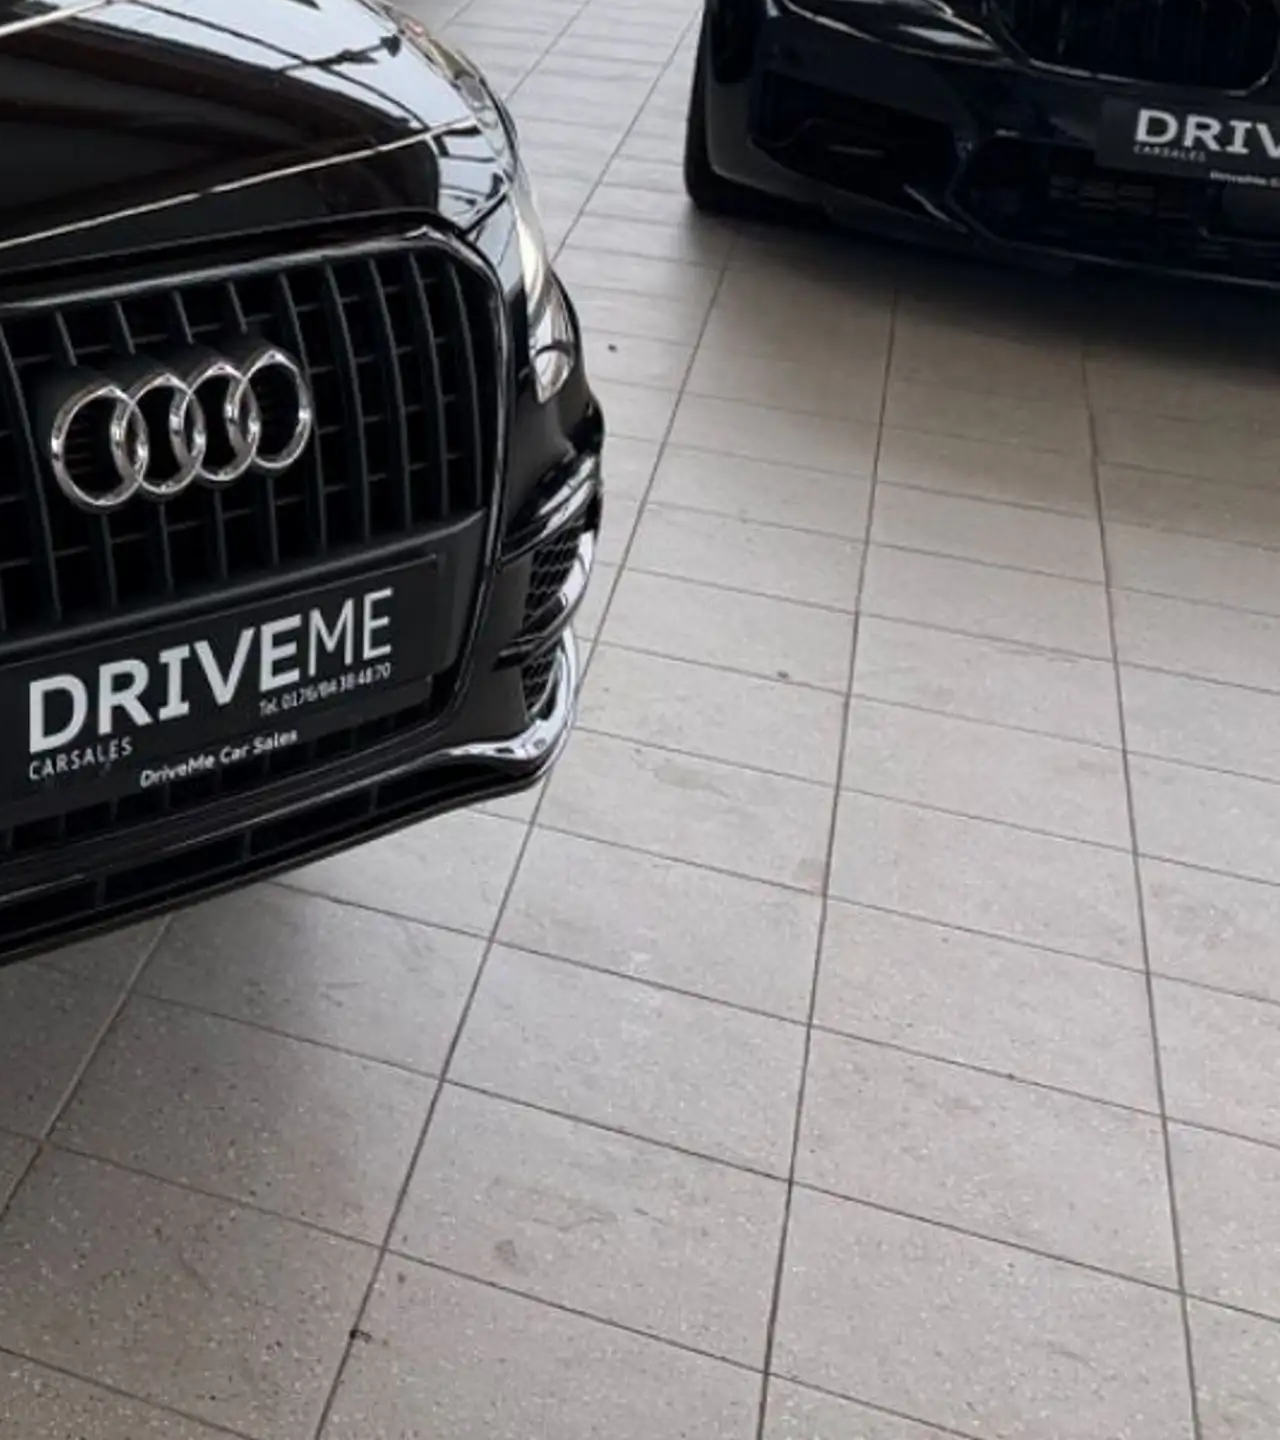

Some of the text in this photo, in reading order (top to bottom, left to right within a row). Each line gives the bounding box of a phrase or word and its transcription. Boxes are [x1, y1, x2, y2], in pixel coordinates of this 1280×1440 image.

[29, 587, 394, 754] DRIVEME
[29, 736, 133, 780] CARSALES
[140, 729, 298, 788] DriveMe Car Sales
